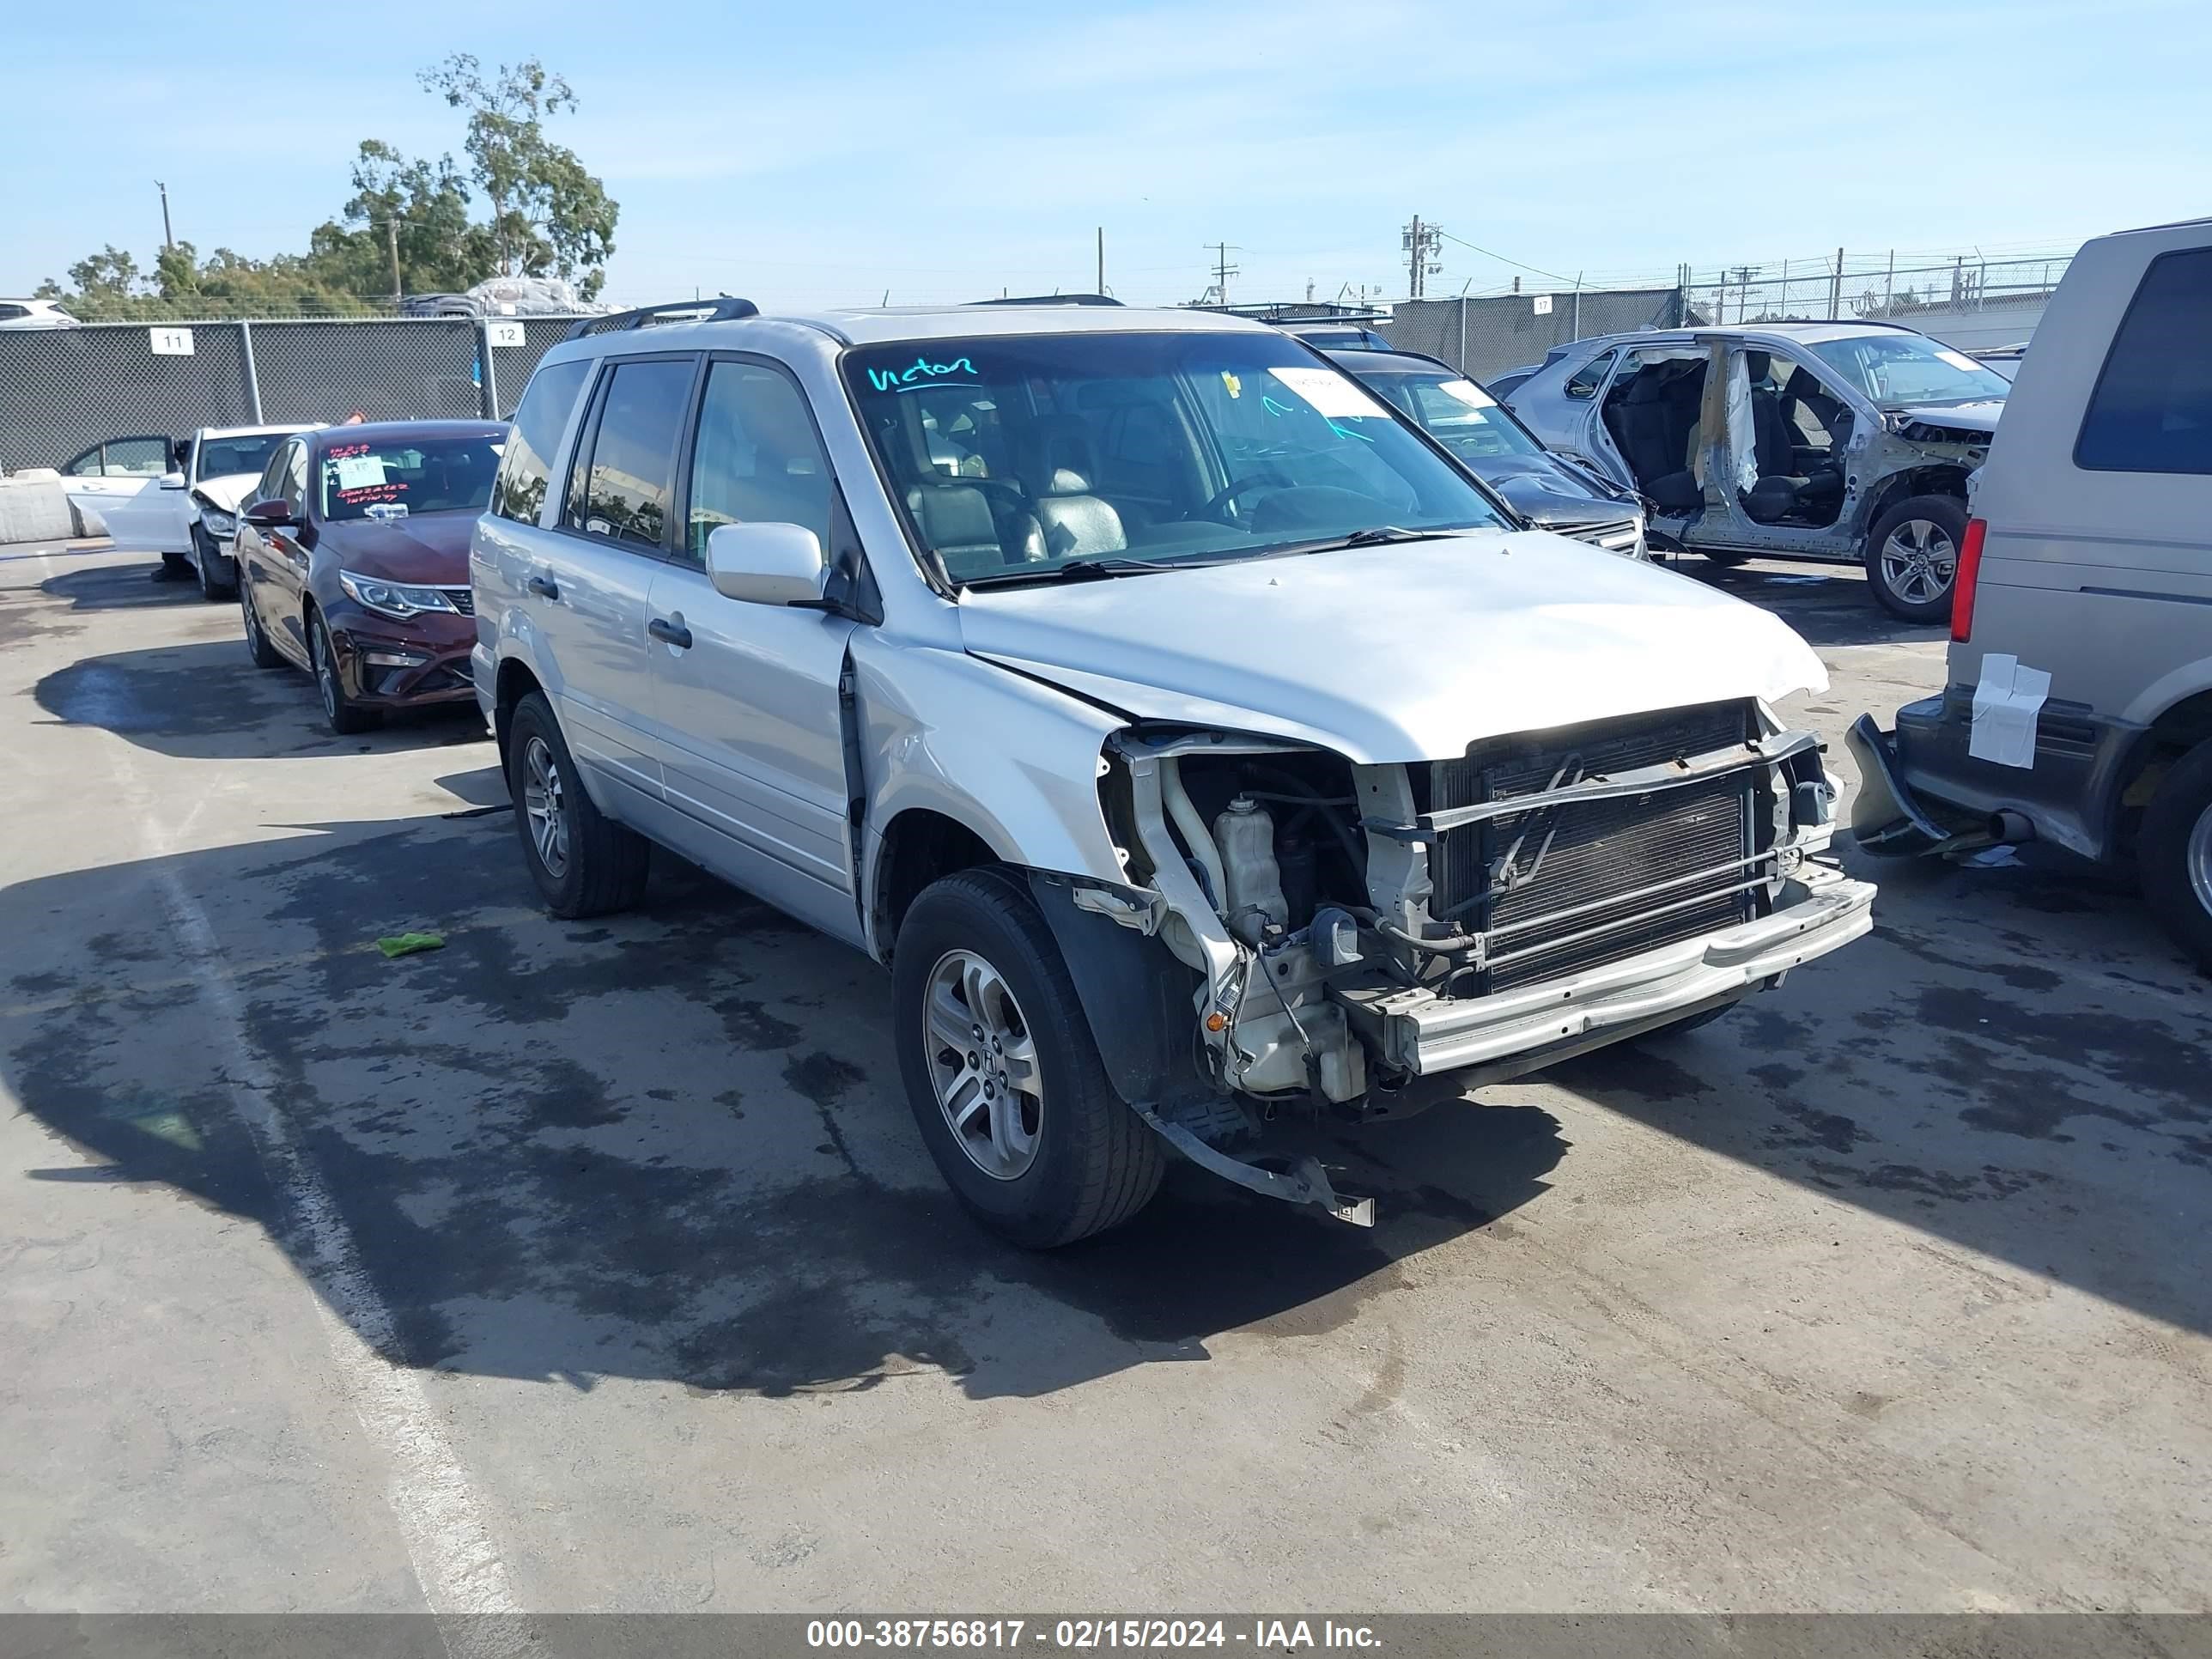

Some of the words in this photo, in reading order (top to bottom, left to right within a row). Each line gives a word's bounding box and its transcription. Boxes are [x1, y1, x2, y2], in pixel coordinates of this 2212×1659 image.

[1539, 301, 1548, 310] 17
[498, 328, 516, 341] 12
[164, 335, 182, 349] 11
